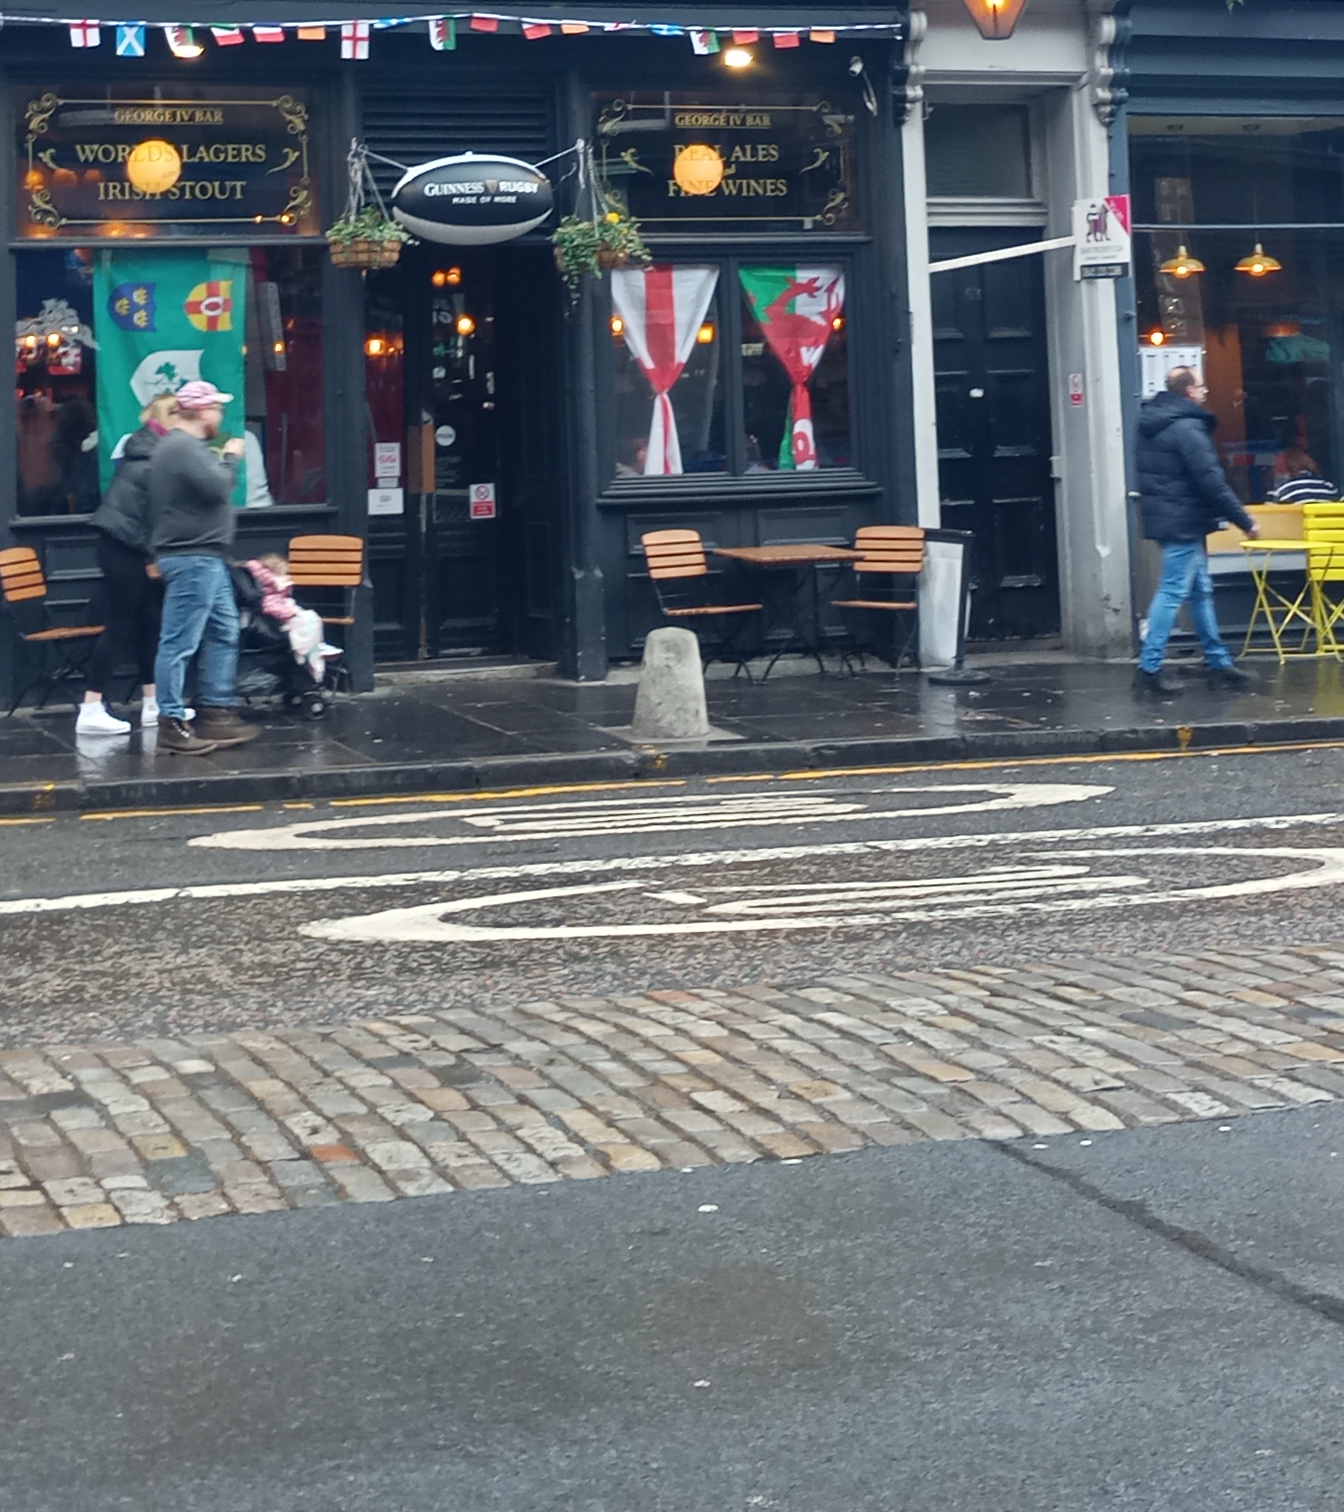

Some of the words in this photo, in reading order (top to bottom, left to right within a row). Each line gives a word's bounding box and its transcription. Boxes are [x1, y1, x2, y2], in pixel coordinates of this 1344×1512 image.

[113, 108, 174, 123] GEORGE
[176, 109, 192, 122] IV
[195, 108, 224, 123] BAR
[674, 113, 727, 126] GEORGE
[729, 114, 744, 126] IV
[746, 114, 771, 127] BAR
[181, 143, 267, 163] LAGERS
[730, 144, 779, 162] ALES
[97, 180, 162, 201] IRISH
[168, 180, 248, 200] STOUT
[424, 181, 485, 197] GUINNESS
[499, 181, 539, 194] RUGBY
[721, 179, 788, 197] WINES
